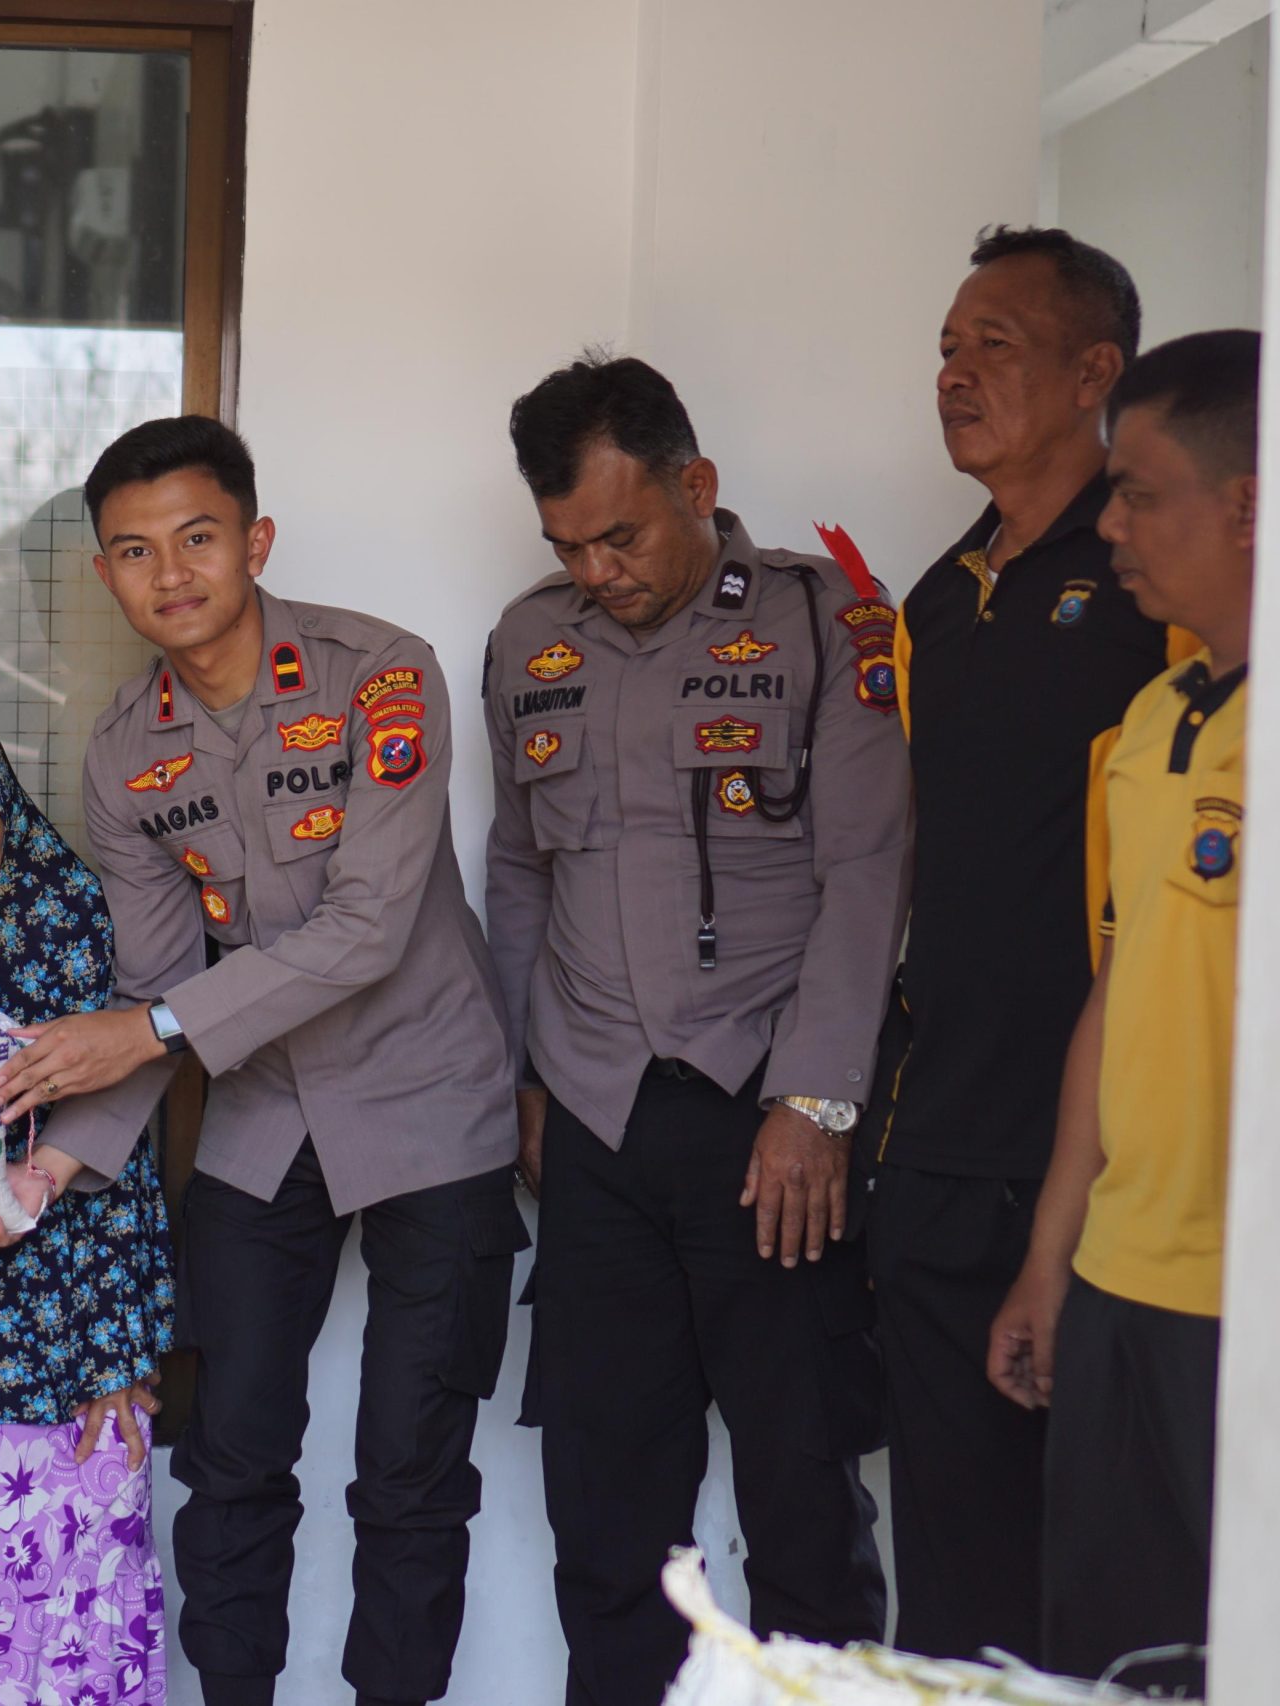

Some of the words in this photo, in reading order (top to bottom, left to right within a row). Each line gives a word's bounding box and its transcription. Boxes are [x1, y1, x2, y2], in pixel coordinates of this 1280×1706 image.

[360, 671, 414, 702] POLRES
[681, 674, 784, 699] POLRI
[267, 760, 352, 797] POLR
